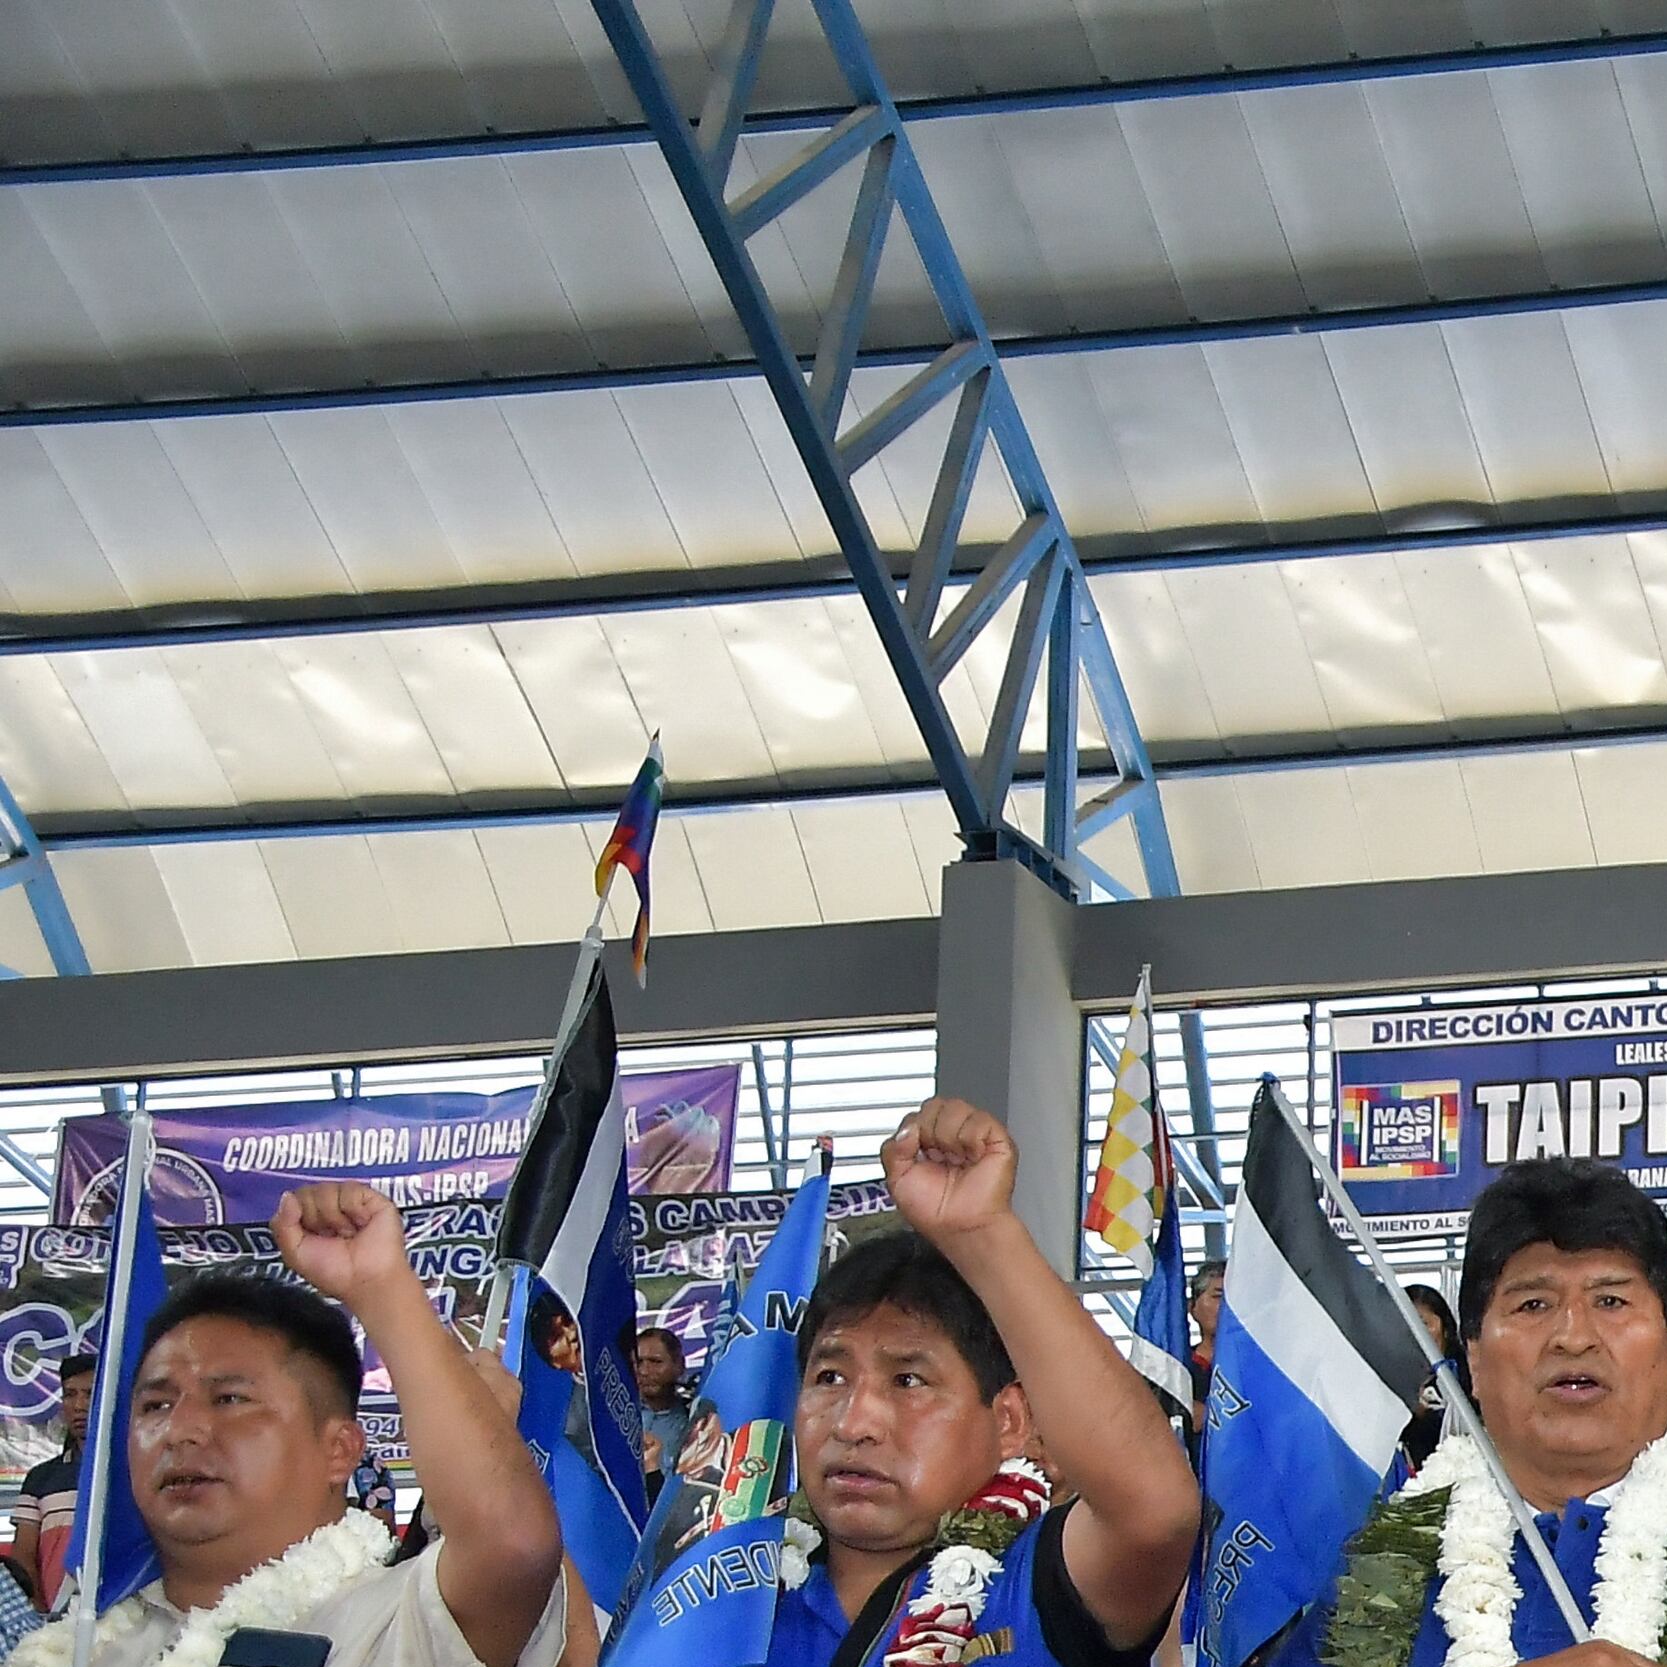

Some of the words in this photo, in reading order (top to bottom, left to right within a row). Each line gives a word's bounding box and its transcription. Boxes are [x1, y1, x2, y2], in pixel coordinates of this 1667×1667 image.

[1372, 1006, 1553, 1044] DIRECCIÓN
[1373, 1105, 1431, 1126] MAS
[1372, 1125, 1432, 1146] IPSP
[223, 1127, 409, 1173] COORDINADORA
[1434, 1217, 1453, 1229] AL
